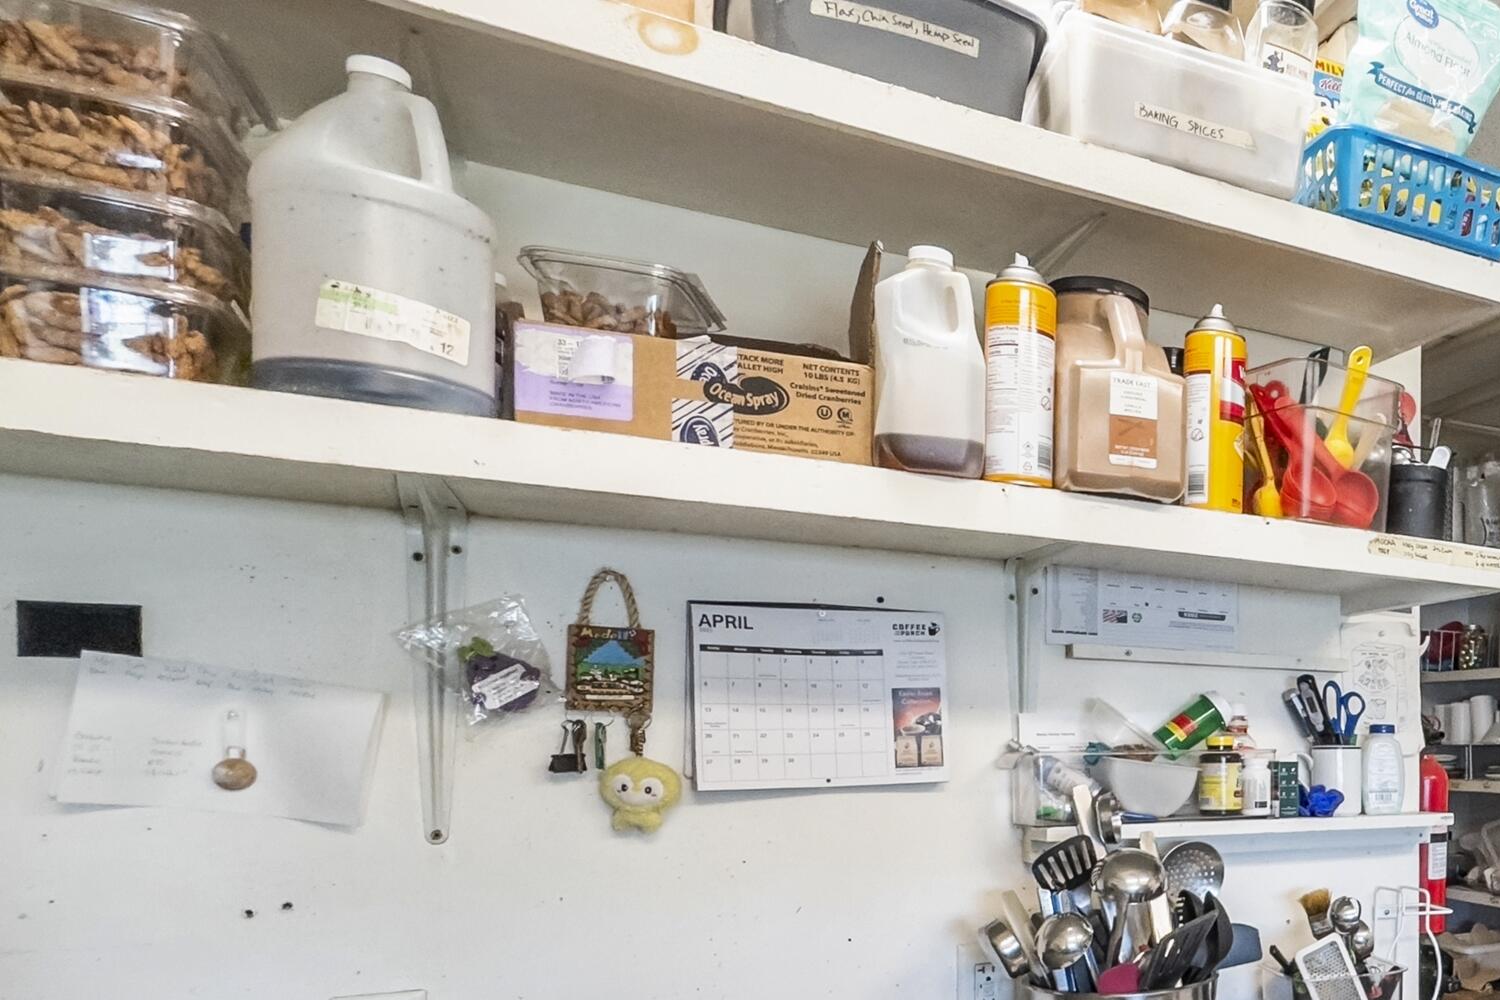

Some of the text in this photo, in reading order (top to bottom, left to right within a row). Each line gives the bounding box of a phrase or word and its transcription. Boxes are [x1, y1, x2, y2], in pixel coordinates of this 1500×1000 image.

[1405, 32, 1443, 63] Almond
[1377, 72, 1407, 96] PERFECT
[1139, 104, 1225, 139] BAKING SPICES
[737, 352, 784, 367] TACK MORE
[763, 365, 784, 375] HIGH
[803, 363, 860, 377] NET CONTENTS
[814, 372, 829, 382] LBS
[709, 383, 780, 412] Ocean Spray
[796, 392, 862, 406] Dried Cranberries
[825, 387, 866, 398] Sweetened
[698, 613, 754, 631] APRIL
[892, 623, 926, 631] COFFEE
